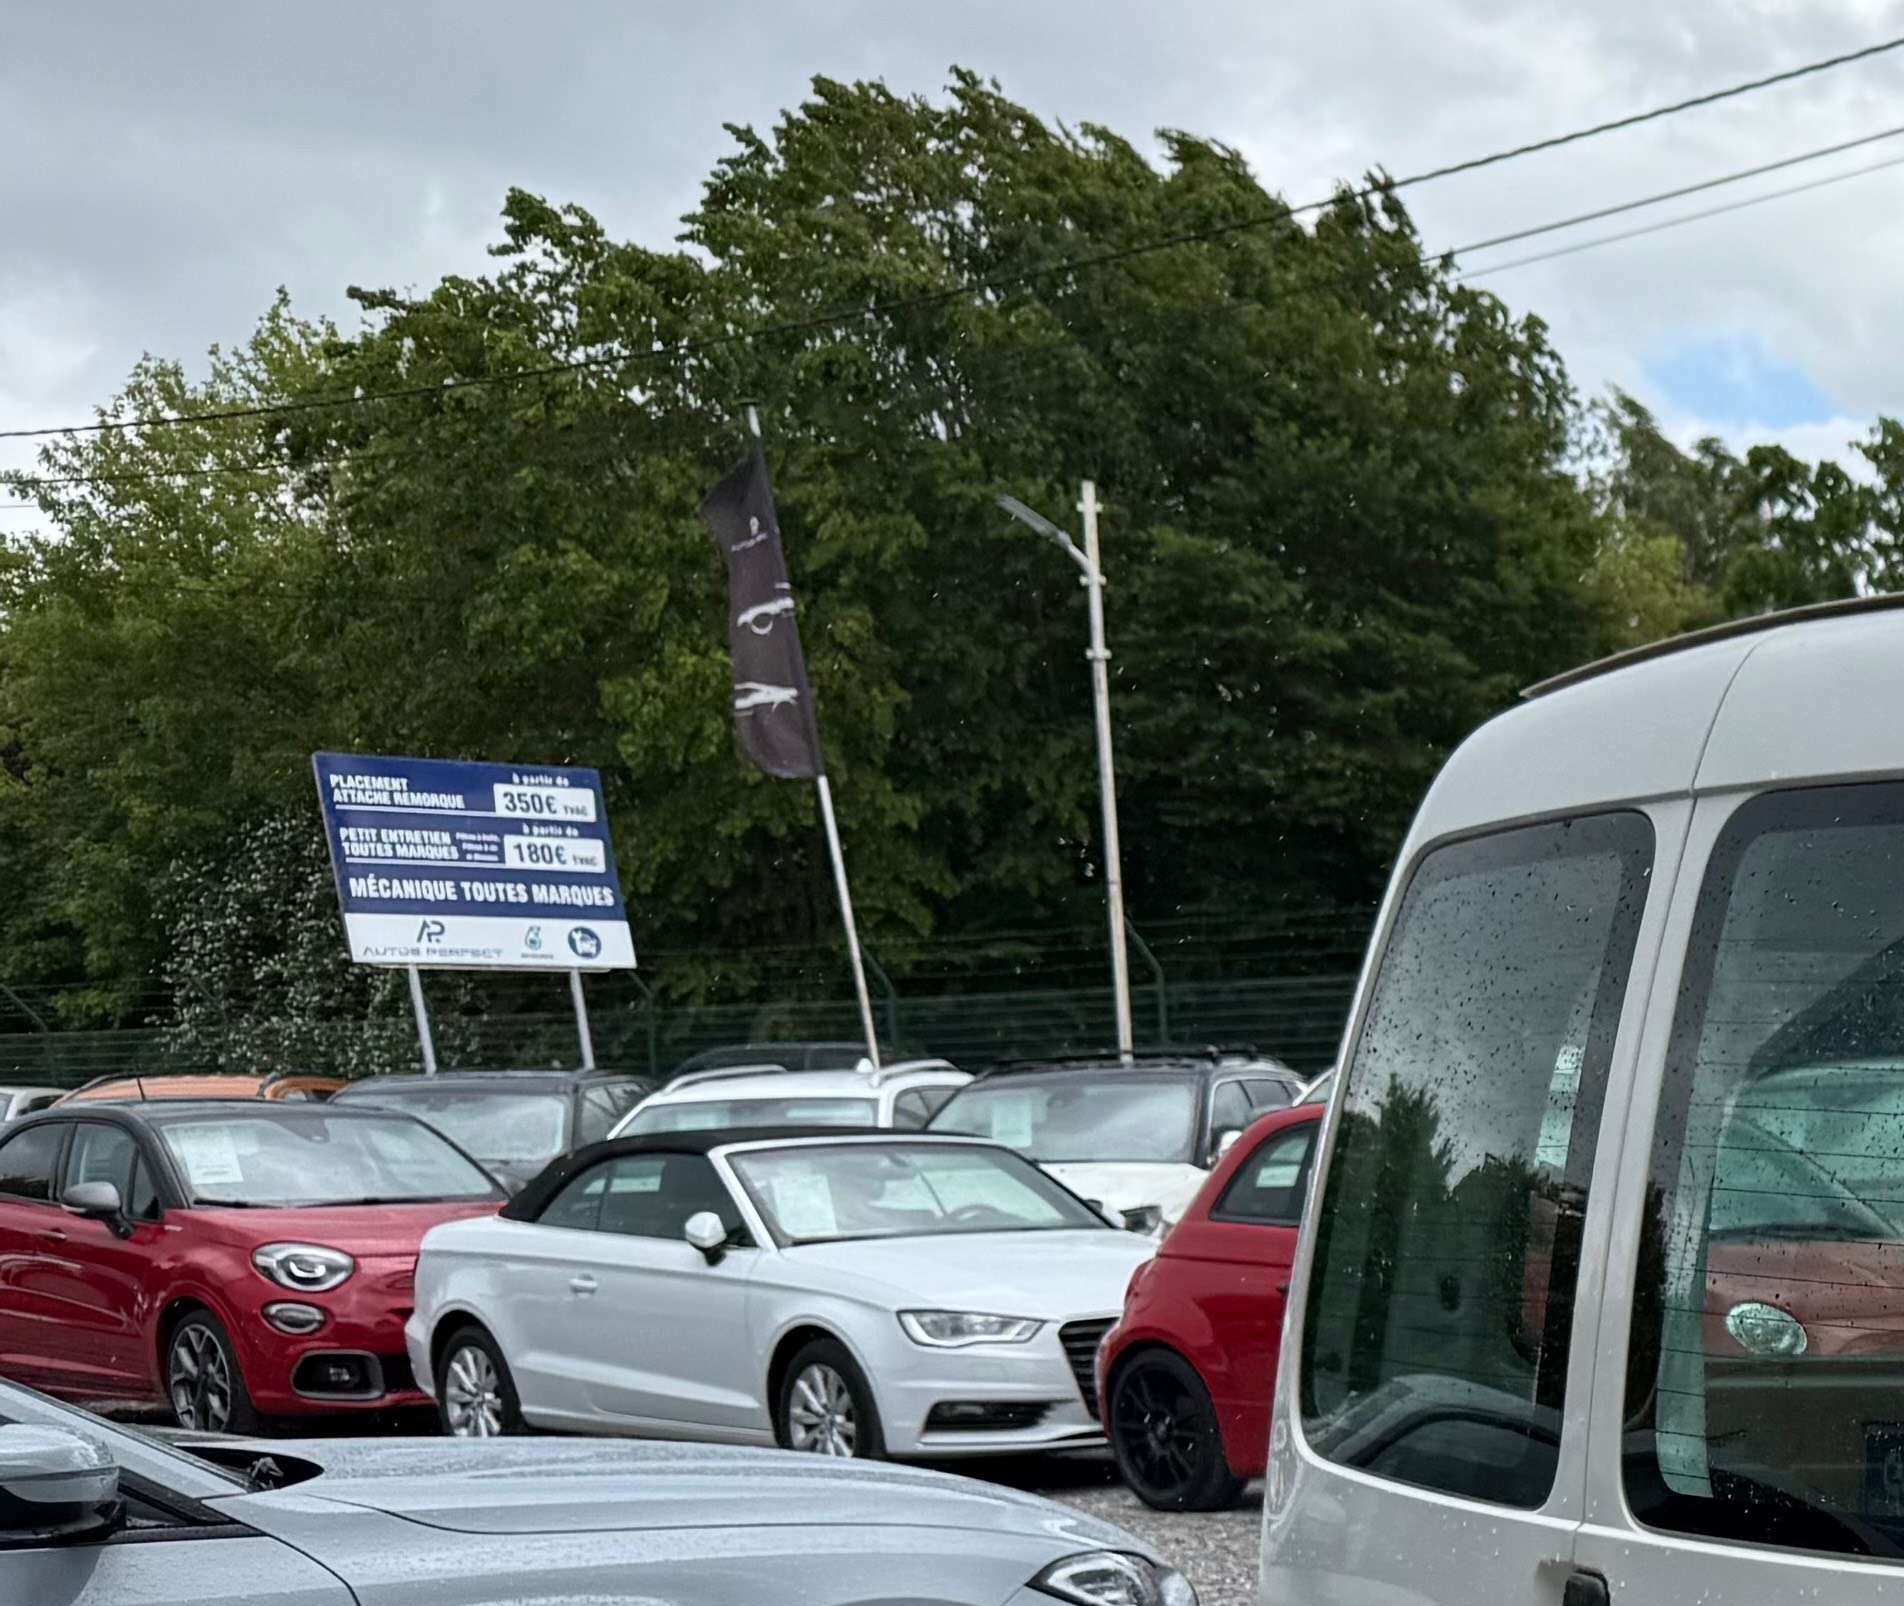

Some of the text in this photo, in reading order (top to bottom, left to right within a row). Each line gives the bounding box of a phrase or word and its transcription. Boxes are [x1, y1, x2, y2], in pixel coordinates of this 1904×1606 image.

[329, 774, 409, 791] PLACEMENT
[333, 789, 466, 809] ATTACHE REMORQUE
[503, 791, 558, 815] 350€
[339, 827, 378, 842] PETIT
[380, 829, 451, 846] ENTRETIEN
[341, 842, 394, 857] TOUTES
[395, 843, 460, 860] MARQUES
[513, 842, 568, 865] 180€
[349, 873, 615, 907] MÉCANIQUE TOUTES MARQUES
